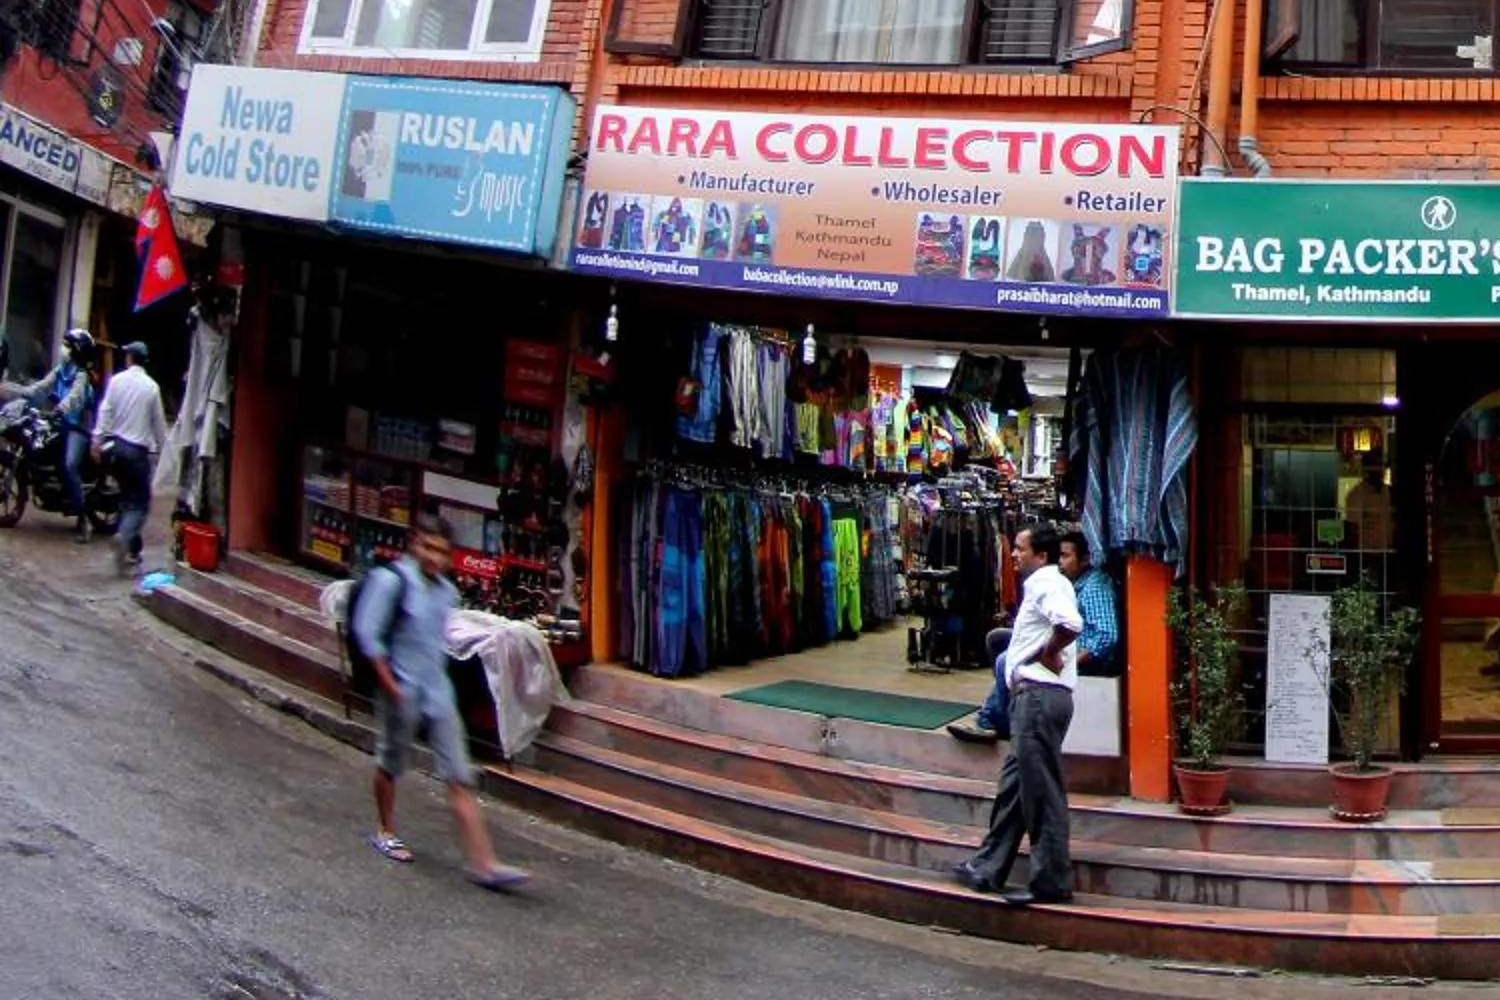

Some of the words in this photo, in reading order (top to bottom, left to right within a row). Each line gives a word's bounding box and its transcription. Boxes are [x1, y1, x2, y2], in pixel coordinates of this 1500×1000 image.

[221, 86, 294, 135] Newa
[401, 112, 535, 156] RUSLAN
[596, 113, 738, 160] RARA
[755, 121, 1166, 178] COLLECTION
[185, 132, 241, 180] Cold
[246, 138, 320, 192] Store
[690, 170, 815, 196] Manufacturer
[884, 181, 1002, 206] Wholesaler
[1077, 190, 1167, 212] Retailer
[795, 231, 893, 247] Kathmandu
[816, 213, 877, 229] Thamel
[817, 248, 865, 264] Nepal
[1195, 236, 1285, 273] BAG
[1231, 282, 1311, 304] Thamel,
[1317, 284, 1431, 303] Kathmandu
